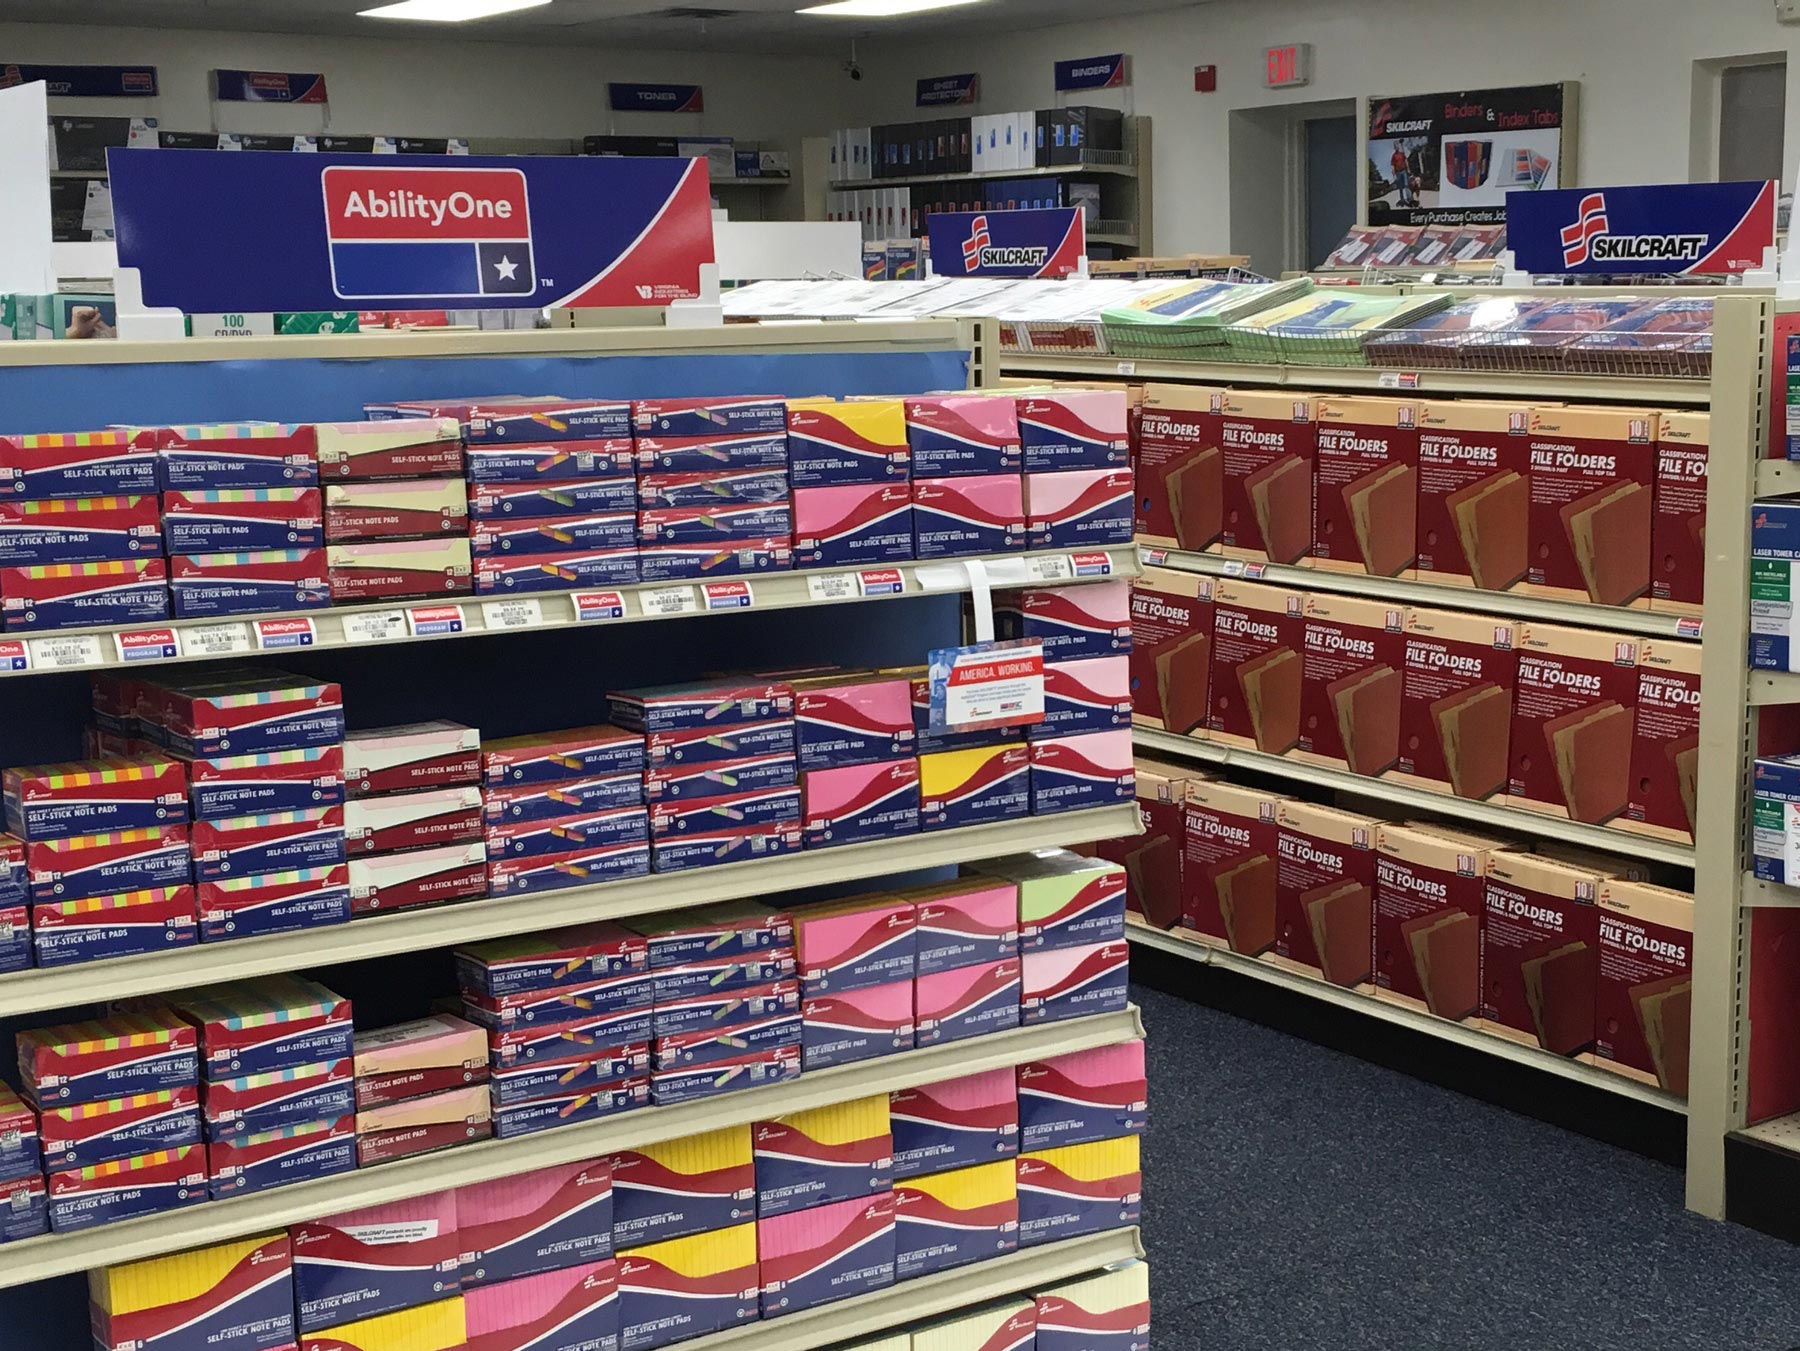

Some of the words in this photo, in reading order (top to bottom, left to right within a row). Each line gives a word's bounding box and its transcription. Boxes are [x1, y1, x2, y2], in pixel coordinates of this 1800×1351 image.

[1071, 65, 1111, 77] BINDERS
[1267, 47, 1296, 83] EXIT
[933, 80, 958, 90] SHEET
[637, 92, 677, 101] TONER
[1444, 103, 1483, 119] Binders
[1486, 108, 1495, 122] &
[1497, 112, 1530, 127] Index
[1533, 109, 1559, 125] Tabs
[1386, 120, 1432, 133] SKILCRAFT
[344, 190, 512, 226] AbilityOne
[1410, 212, 1428, 224] Every
[1429, 211, 1463, 222] Purchase
[1465, 211, 1493, 221] Creates
[1594, 237, 1703, 259] SKILCRAFT
[983, 249, 1046, 266] SKILCRAFT
[541, 279, 554, 287] TM
[222, 315, 244, 327] 100
[1141, 421, 1155, 432] FILE
[1157, 422, 1200, 436] FOLDERS
[1223, 428, 1238, 441] FILE
[1240, 430, 1284, 446] FOLDERS
[1319, 435, 1337, 450] FILE
[1339, 437, 1388, 453] FOLDERS
[1420, 442, 1440, 457] FILE
[1442, 444, 1497, 460] FOLDERS
[169, 464, 204, 472] SELF-STICK
[208, 463, 226, 471] NOTE
[392, 455, 424, 463] SELF-STICK
[445, 454, 460, 462] PADS
[1531, 450, 1553, 465] FILE
[1556, 453, 1616, 470] FOLDERS
[1659, 458, 1683, 473] FILE
[64, 469, 106, 478] SELF-STICK
[110, 468, 131, 476] NOTE
[134, 467, 152, 475] PADS
[864, 573, 897, 582] AbilityOne
[183, 591, 218, 599] SELF-STICK
[221, 589, 239, 597] NOTE
[242, 588, 257, 596] PADS
[709, 586, 744, 596] AbilityOne
[580, 596, 617, 607] AbilityOne
[1132, 601, 1147, 613] FILE
[1149, 603, 1190, 620] FOLDERS
[262, 622, 305, 632] AbilityOne
[1216, 615, 1232, 629] FILE
[1234, 618, 1278, 637] FOLDERS
[123, 633, 169, 644] AbilityOne
[1305, 631, 1323, 645] FILE
[1325, 634, 1375, 654] FOLDERS
[1406, 648, 1427, 663] FILE
[1428, 651, 1482, 671] FOLDERS
[960, 667, 995, 681] AMERICA.
[997, 662, 1035, 676] WORKING.
[1519, 664, 1540, 680] FILE
[1542, 667, 1601, 688] FOLDERS
[1639, 683, 1661, 698] FILE
[1664, 686, 1700, 702] FOLD
[802, 744, 831, 752] SELF-STICK
[411, 767, 443, 776] SELF-STICK
[446, 765, 462, 773] NOTE
[29, 810, 70, 822] SELF-STICK
[74, 808, 95, 817] NOTE
[98, 806, 117, 815] PADS
[1186, 816, 1203, 830] FILE
[1205, 820, 1250, 841] FOLDERS
[267, 847, 300, 856] SELF-STICK
[303, 845, 320, 853] NOTE
[1278, 839, 1295, 854] FILE
[1297, 844, 1343, 868] FOLDERS
[1377, 867, 1394, 884] FILE
[1396, 874, 1447, 897] FOLDERS
[272, 906, 305, 916] SELF-STICK
[308, 903, 325, 912] NOTE
[327, 901, 342, 910] PADS
[1486, 893, 1506, 910] FILE
[1508, 898, 1563, 925] FOLDERS
[41, 935, 82, 947] SELF-STICK
[86, 932, 106, 942] NOTE
[109, 929, 127, 939] PADS
[1599, 924, 1622, 943] FILE
[1625, 931, 1686, 959] FOLDERS
[107, 1067, 148, 1079] SELF-STICK
[152, 1064, 172, 1074] NOTE
[175, 1062, 193, 1071] PADS
[1024, 1126, 1052, 1136] SELF-STICK
[1055, 1124, 1069, 1132] NOTE
[1071, 1122, 1084, 1130] PADS
[57, 1199, 97, 1214] SELF-STICK
[100, 1195, 120, 1206] NOTE
[123, 1191, 141, 1202] PADS
[614, 1219, 647, 1232] SELF-STICK
[650, 1216, 666, 1226] NOTE
[669, 1214, 683, 1223] PADS
[537, 1243, 571, 1256] SELF-STICK
[575, 1239, 592, 1250] NOTE
[595, 1236, 610, 1246] PADS
[301, 1297, 338, 1314] SELF-STICK
[342, 1293, 361, 1305] NOTE
[363, 1289, 380, 1301] PADS
[208, 1327, 247, 1343] SELF-STICK
[251, 1323, 270, 1334] NOTE
[273, 1319, 290, 1329] PADS
